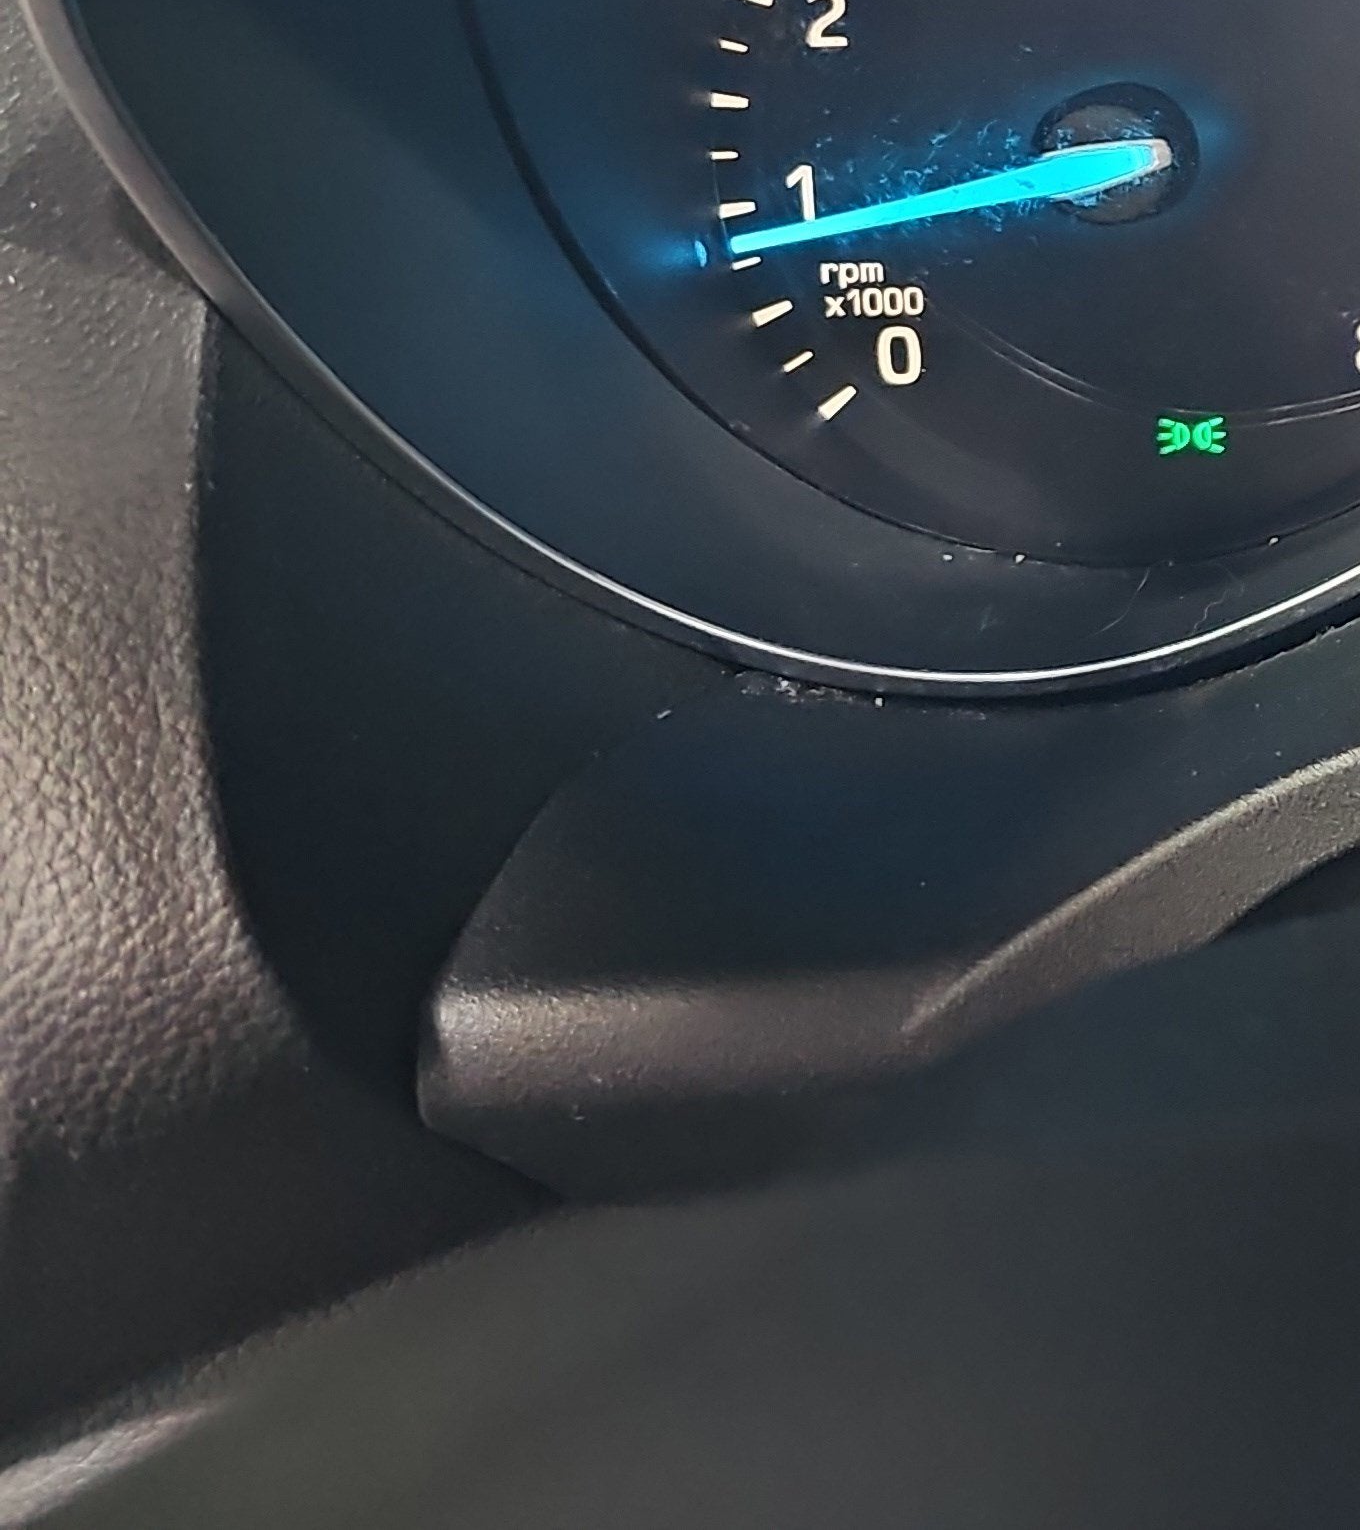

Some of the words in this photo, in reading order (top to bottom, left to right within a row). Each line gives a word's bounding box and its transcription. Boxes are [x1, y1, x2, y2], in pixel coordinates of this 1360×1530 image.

[785, 165, 816, 221] 1
[820, 261, 885, 285] rpm
[825, 286, 924, 317] x1000
[877, 326, 923, 386] 0
